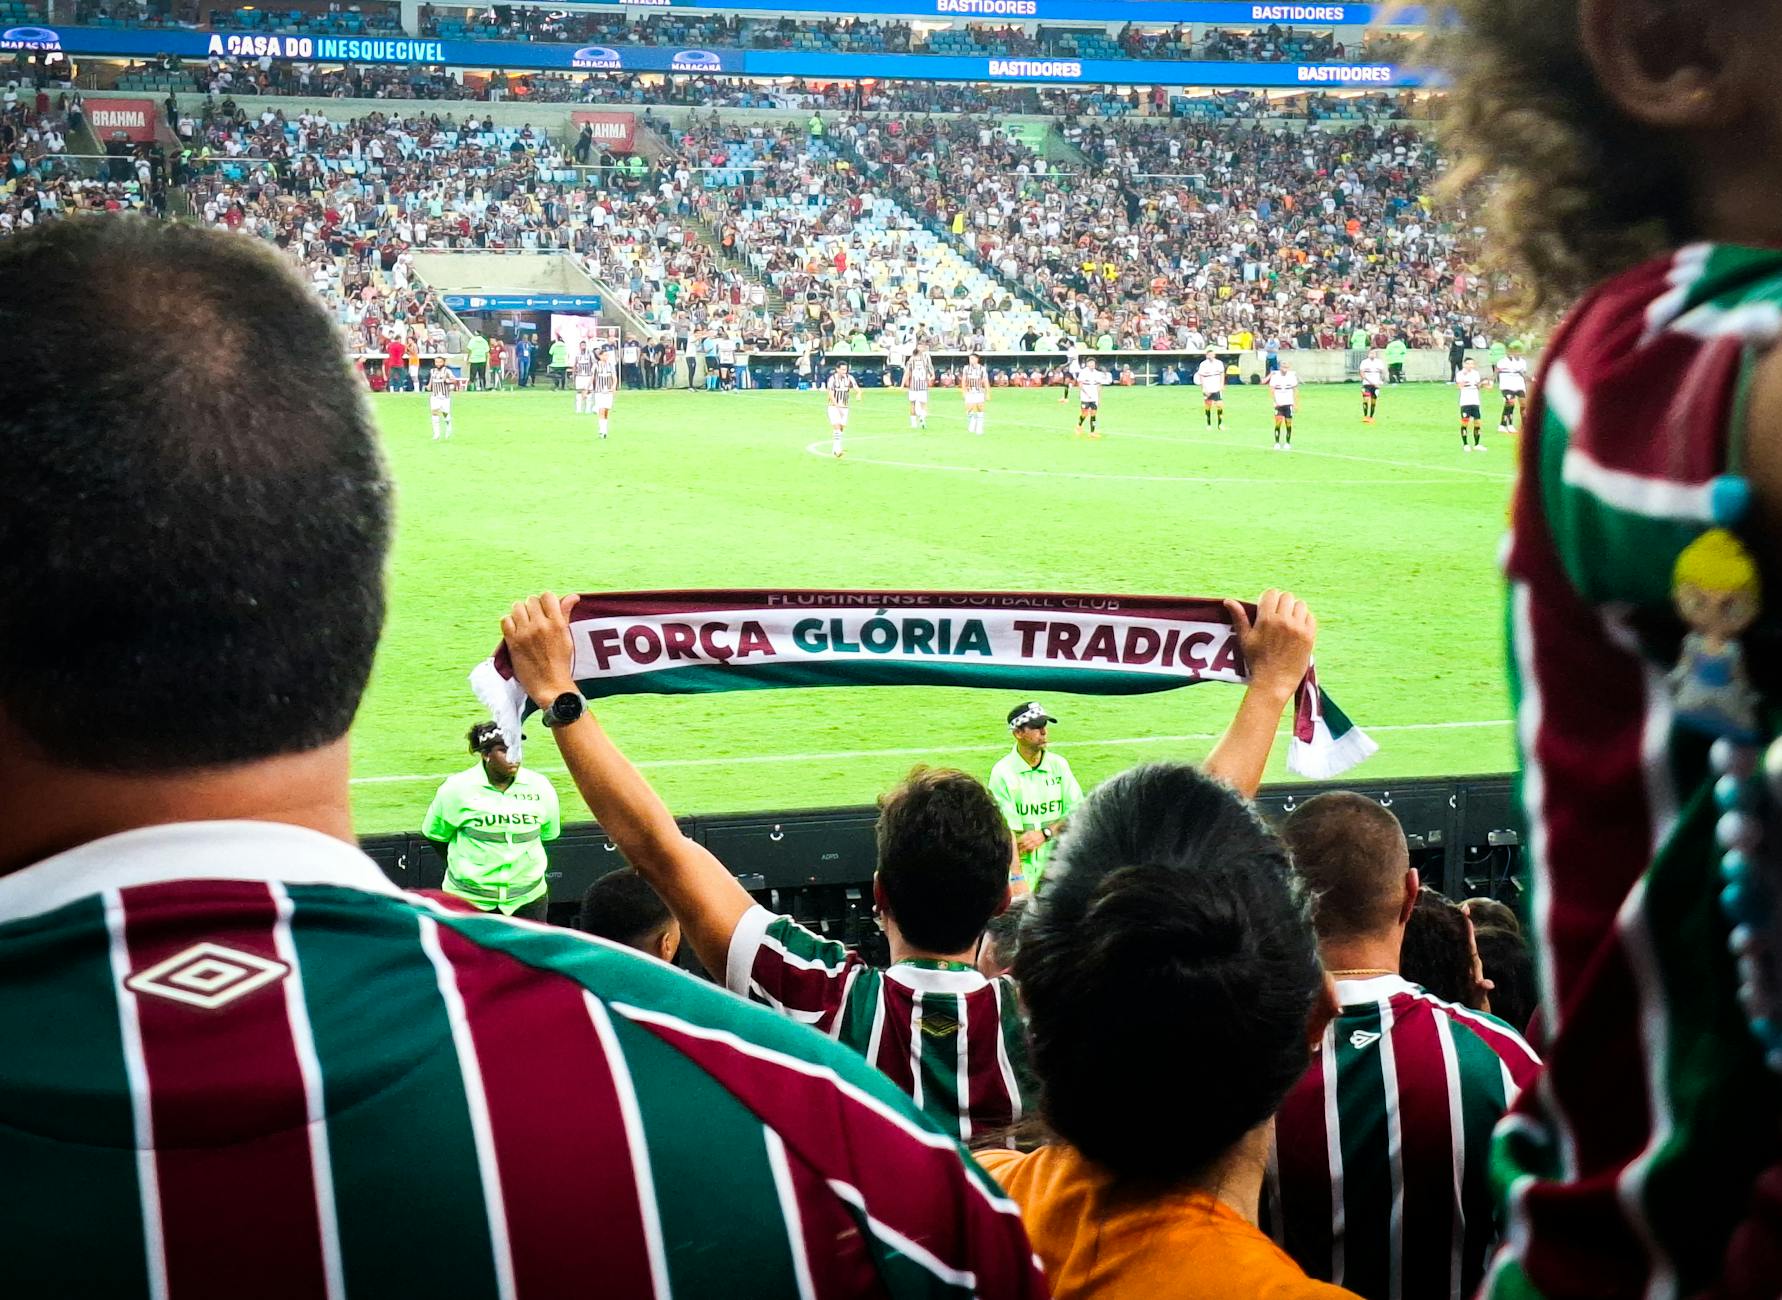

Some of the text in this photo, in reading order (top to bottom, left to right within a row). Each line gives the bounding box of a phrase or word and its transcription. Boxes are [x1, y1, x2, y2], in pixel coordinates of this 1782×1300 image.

[937, 0, 1037, 16] BASTIDORES
[1252, 5, 1345, 21] BASTIDORES
[208, 34, 446, 62] A CASA DO INESQUECÍVEL
[988, 60, 1082, 78] BASTIDORES
[1297, 65, 1391, 82] BASTIDORES
[92, 110, 146, 128] BRAHMA
[767, 593, 931, 606] FLUMINENSE
[588, 620, 776, 670] FORÇA
[792, 608, 992, 656] GLÓRIA
[1016, 800, 1064, 816] UNSET
